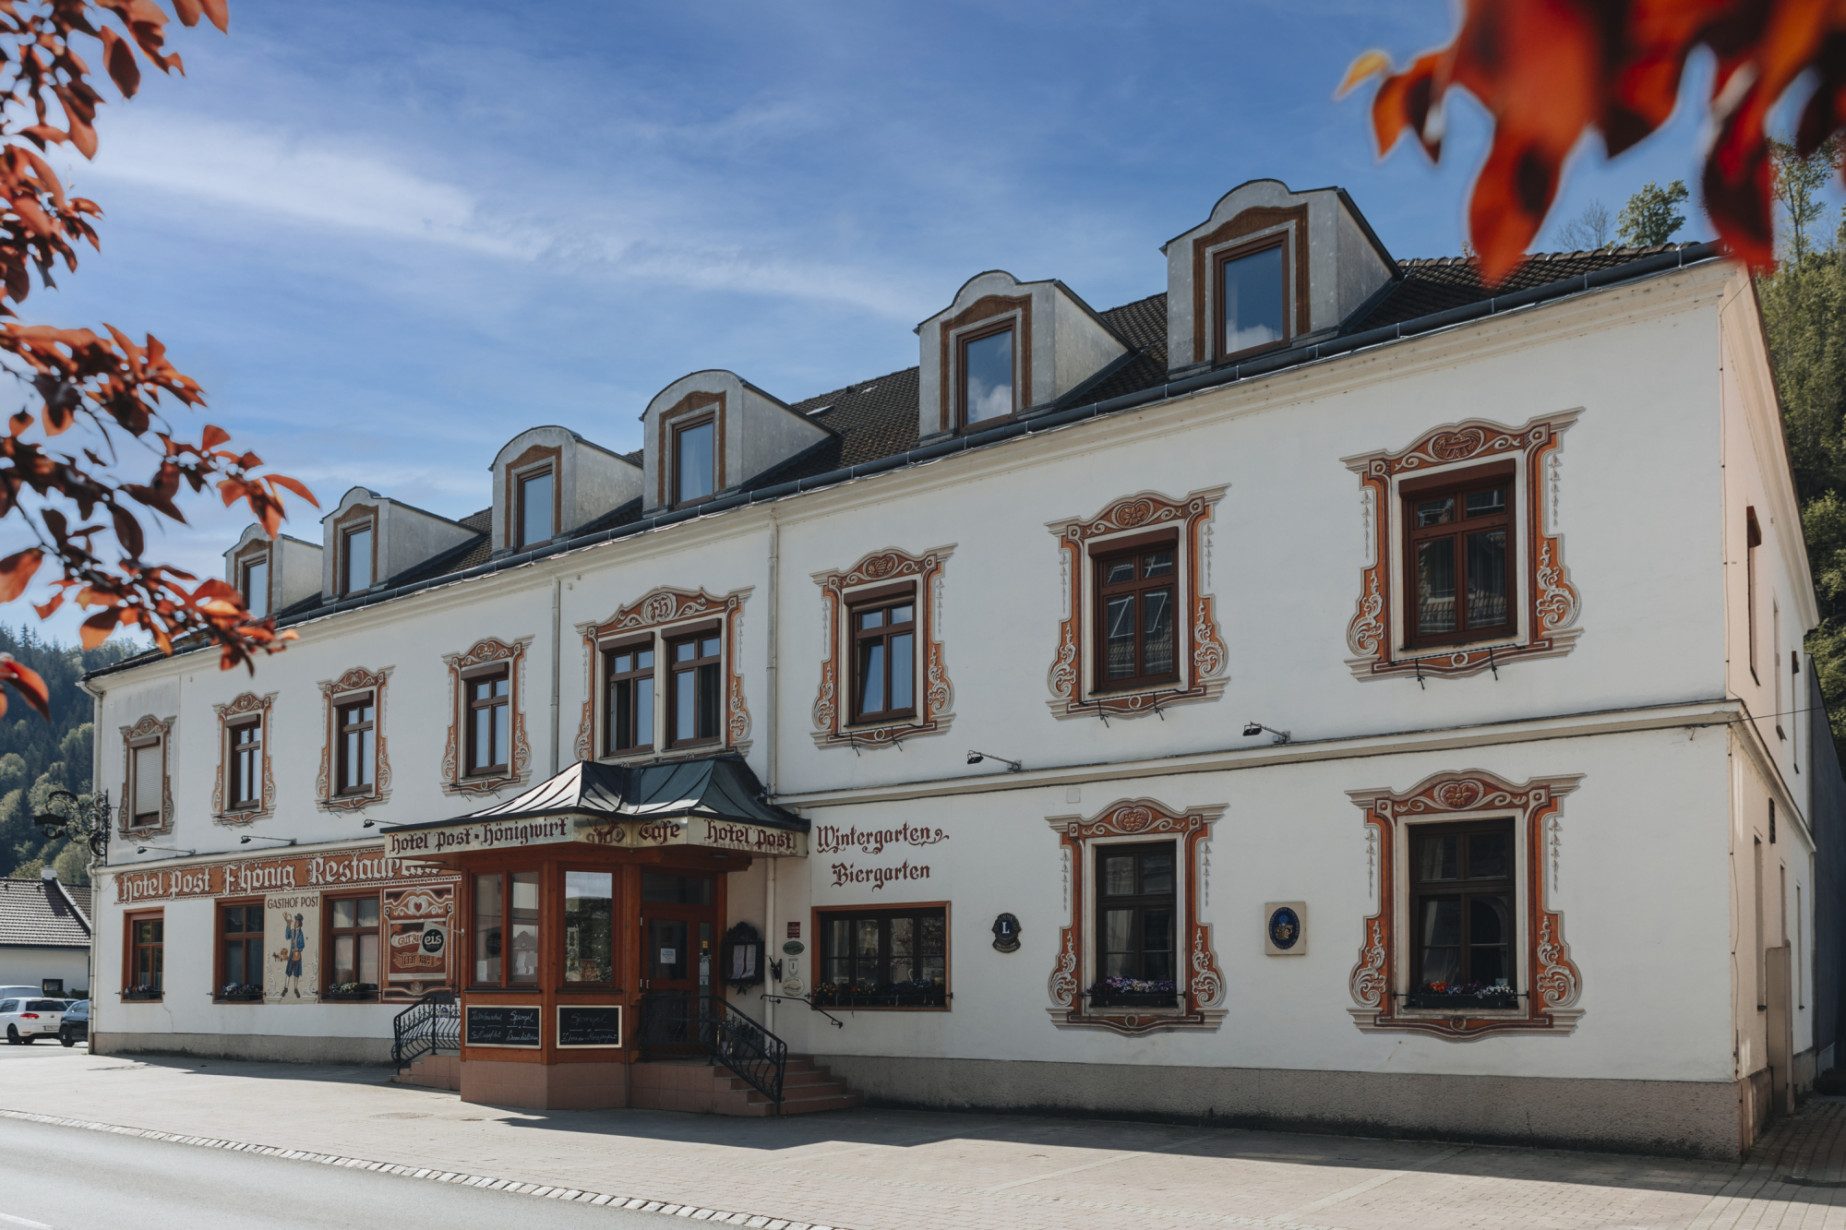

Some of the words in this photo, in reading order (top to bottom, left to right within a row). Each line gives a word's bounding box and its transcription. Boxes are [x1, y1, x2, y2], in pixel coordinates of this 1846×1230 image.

[816, 822, 949, 855] Wintergarten
[309, 854, 440, 886] Restaur
[831, 860, 930, 892] Biergarten
[267, 897, 299, 909] GASTHOF
[300, 896, 319, 908] POST
[424, 932, 442, 945] eis
